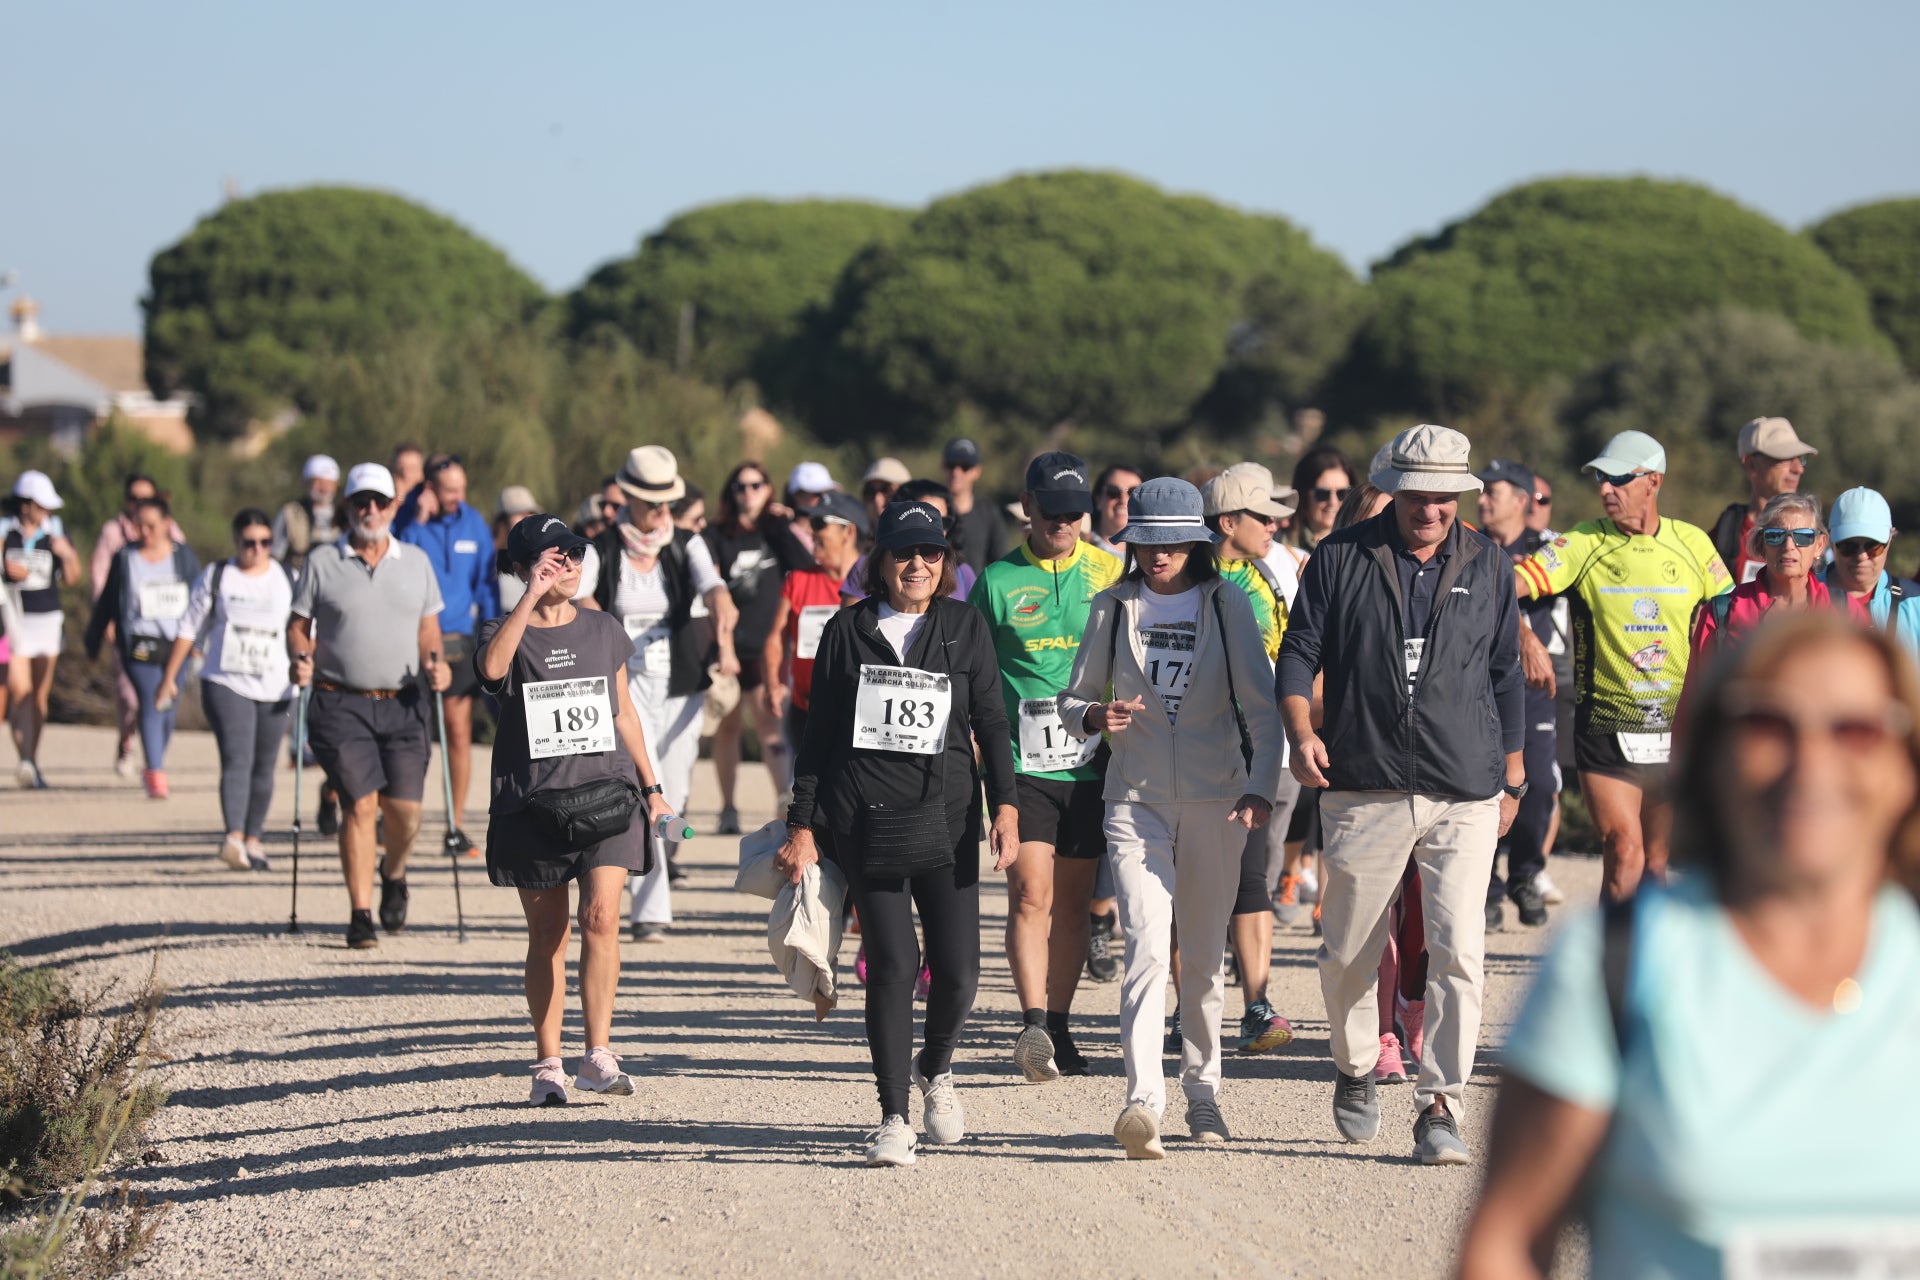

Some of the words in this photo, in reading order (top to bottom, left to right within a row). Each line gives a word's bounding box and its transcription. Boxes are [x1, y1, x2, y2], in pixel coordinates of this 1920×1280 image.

[1624, 624, 1669, 632] VENTURA
[1144, 631, 1179, 640] CARRERA
[544, 654, 571, 663] different
[547, 660, 576, 670] beautiful.
[877, 670, 913, 679] CARRERA
[871, 678, 903, 686] MARCHA
[539, 682, 571, 692] CARRERA
[536, 691, 566, 700] MARCHA
[881, 698, 935, 728] 183
[550, 705, 599, 734] 189
[1041, 724, 1088, 749] 17
